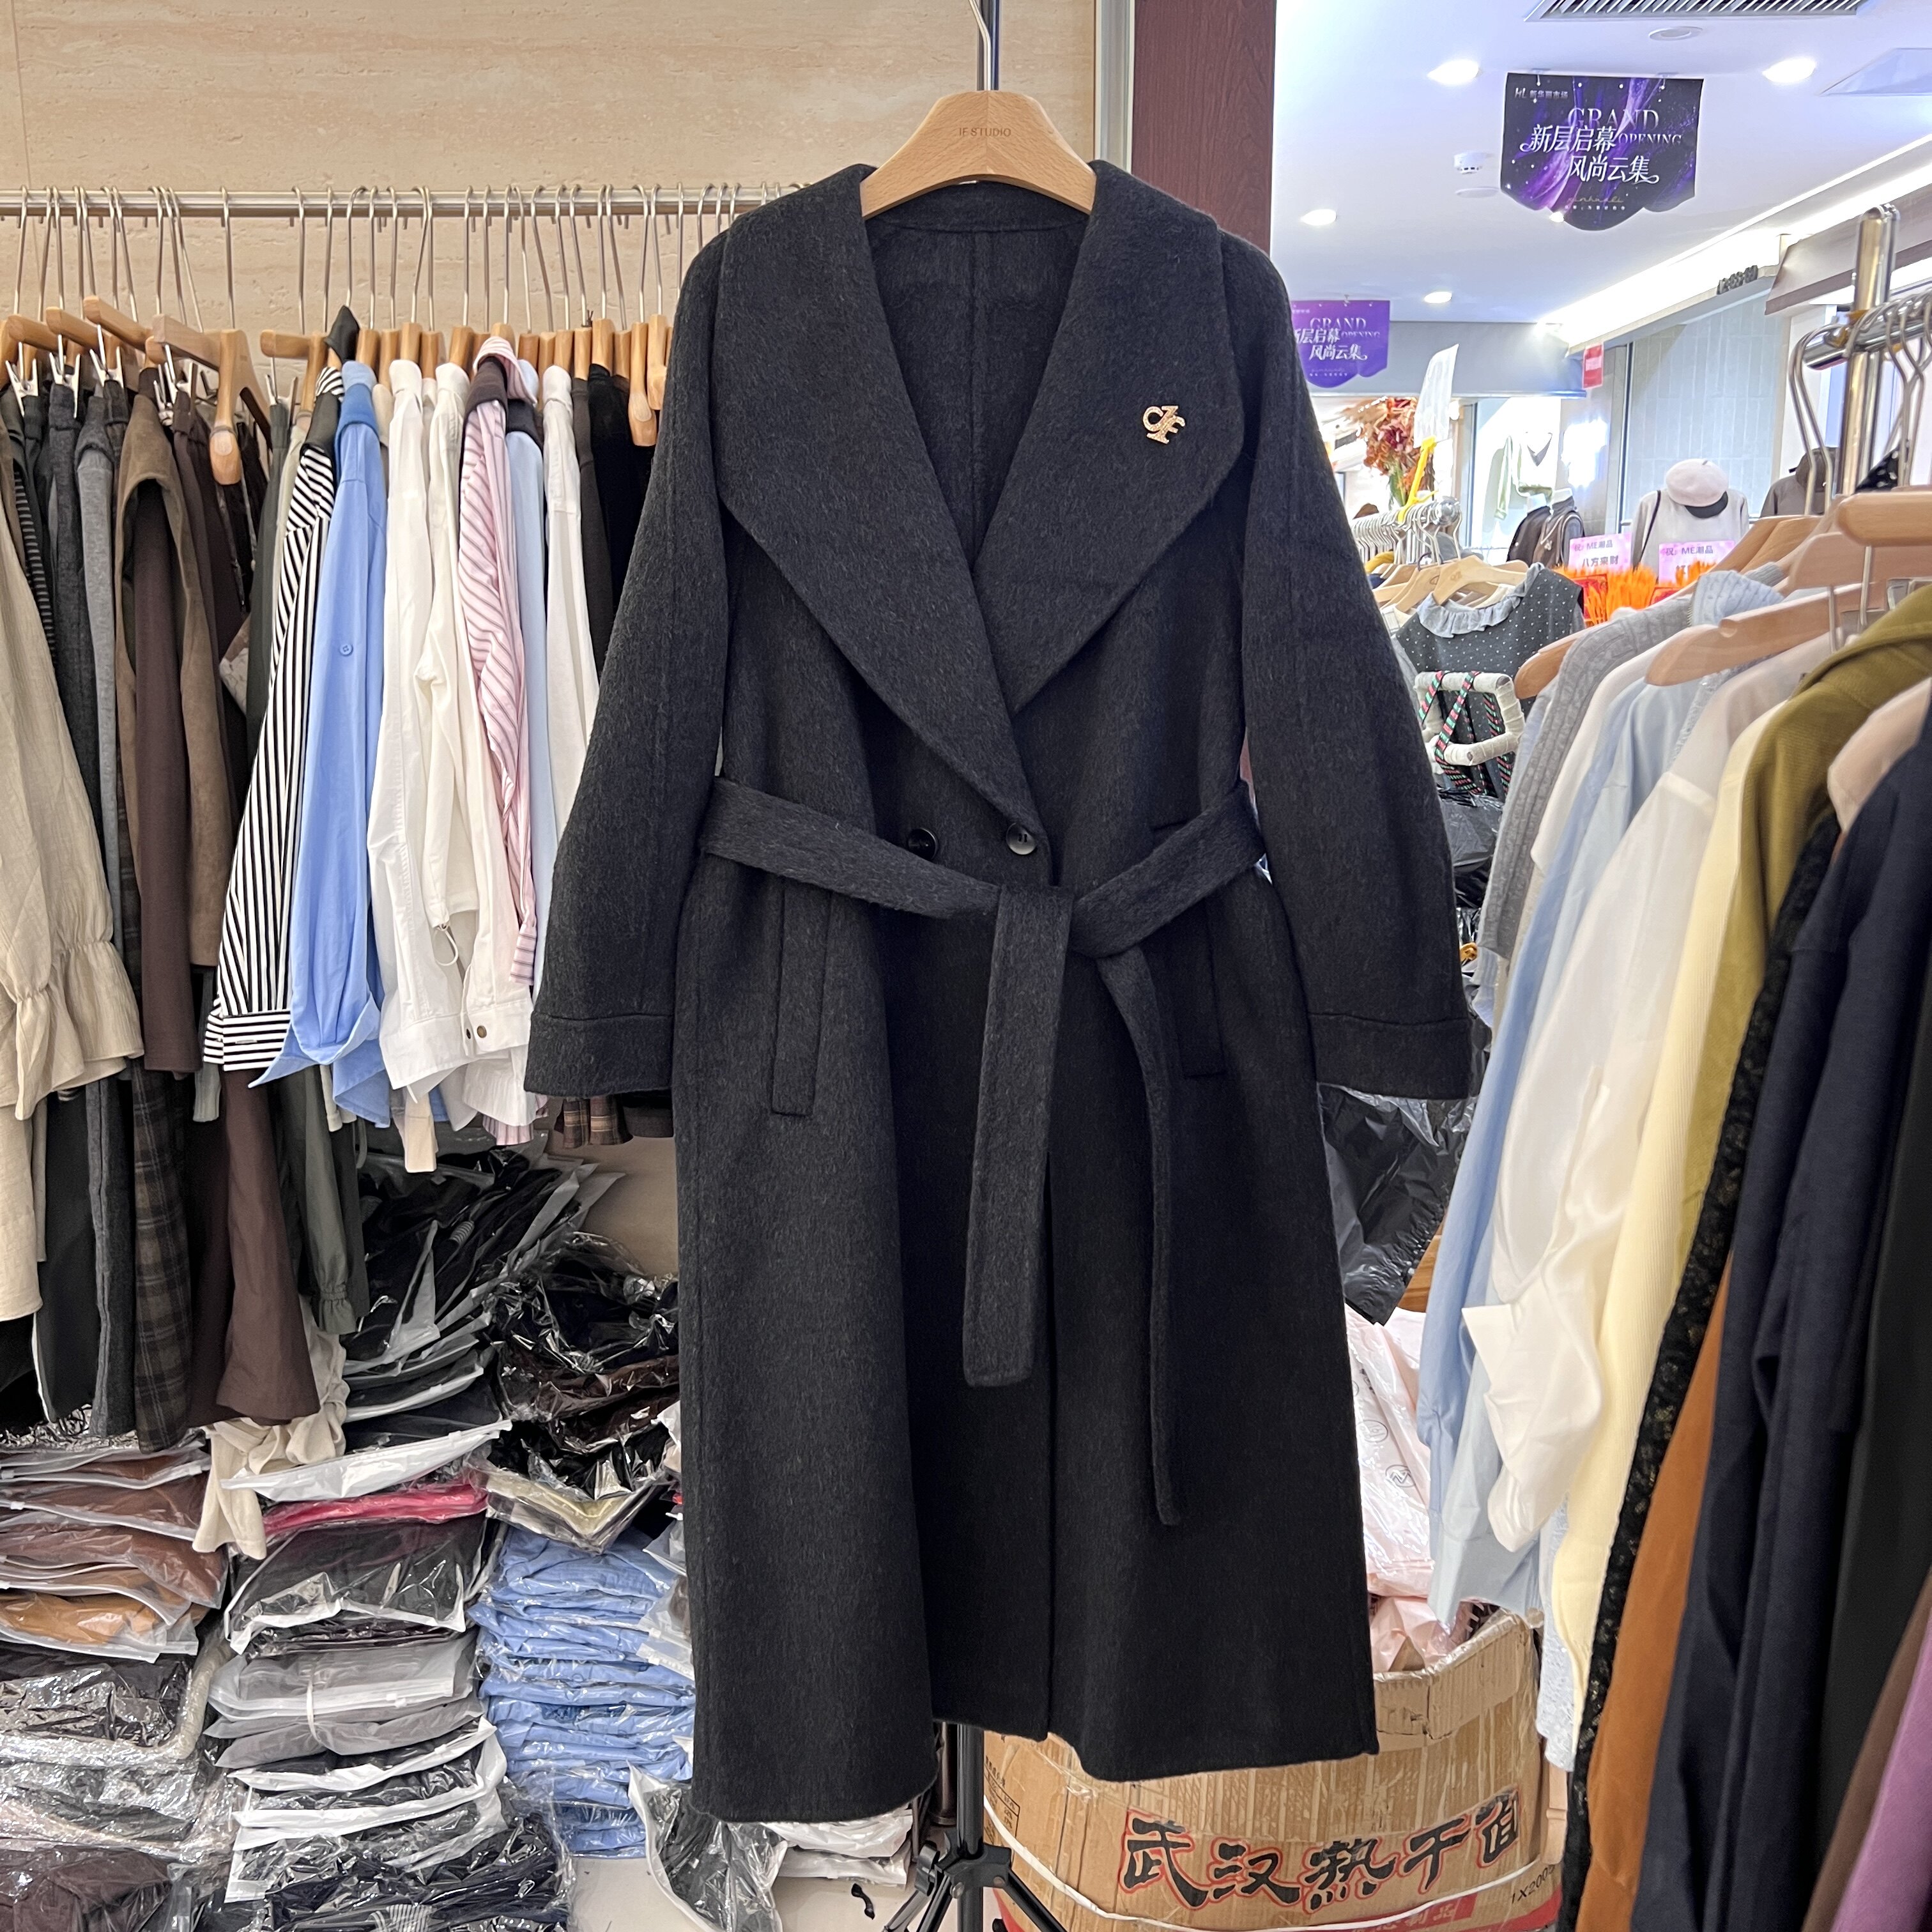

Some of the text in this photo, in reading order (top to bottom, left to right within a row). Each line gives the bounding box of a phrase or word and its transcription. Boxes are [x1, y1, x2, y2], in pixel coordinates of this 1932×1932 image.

[1567, 107, 1659, 130] GRAND
[970, 127, 1011, 137] STUDIO
[1521, 124, 1617, 153] 新层启幕
[1618, 132, 1682, 144] OPENING
[1567, 154, 1660, 185] 风尚云集
[1310, 317, 1367, 330] GRAND
[1309, 344, 1368, 361] 风尚云集
